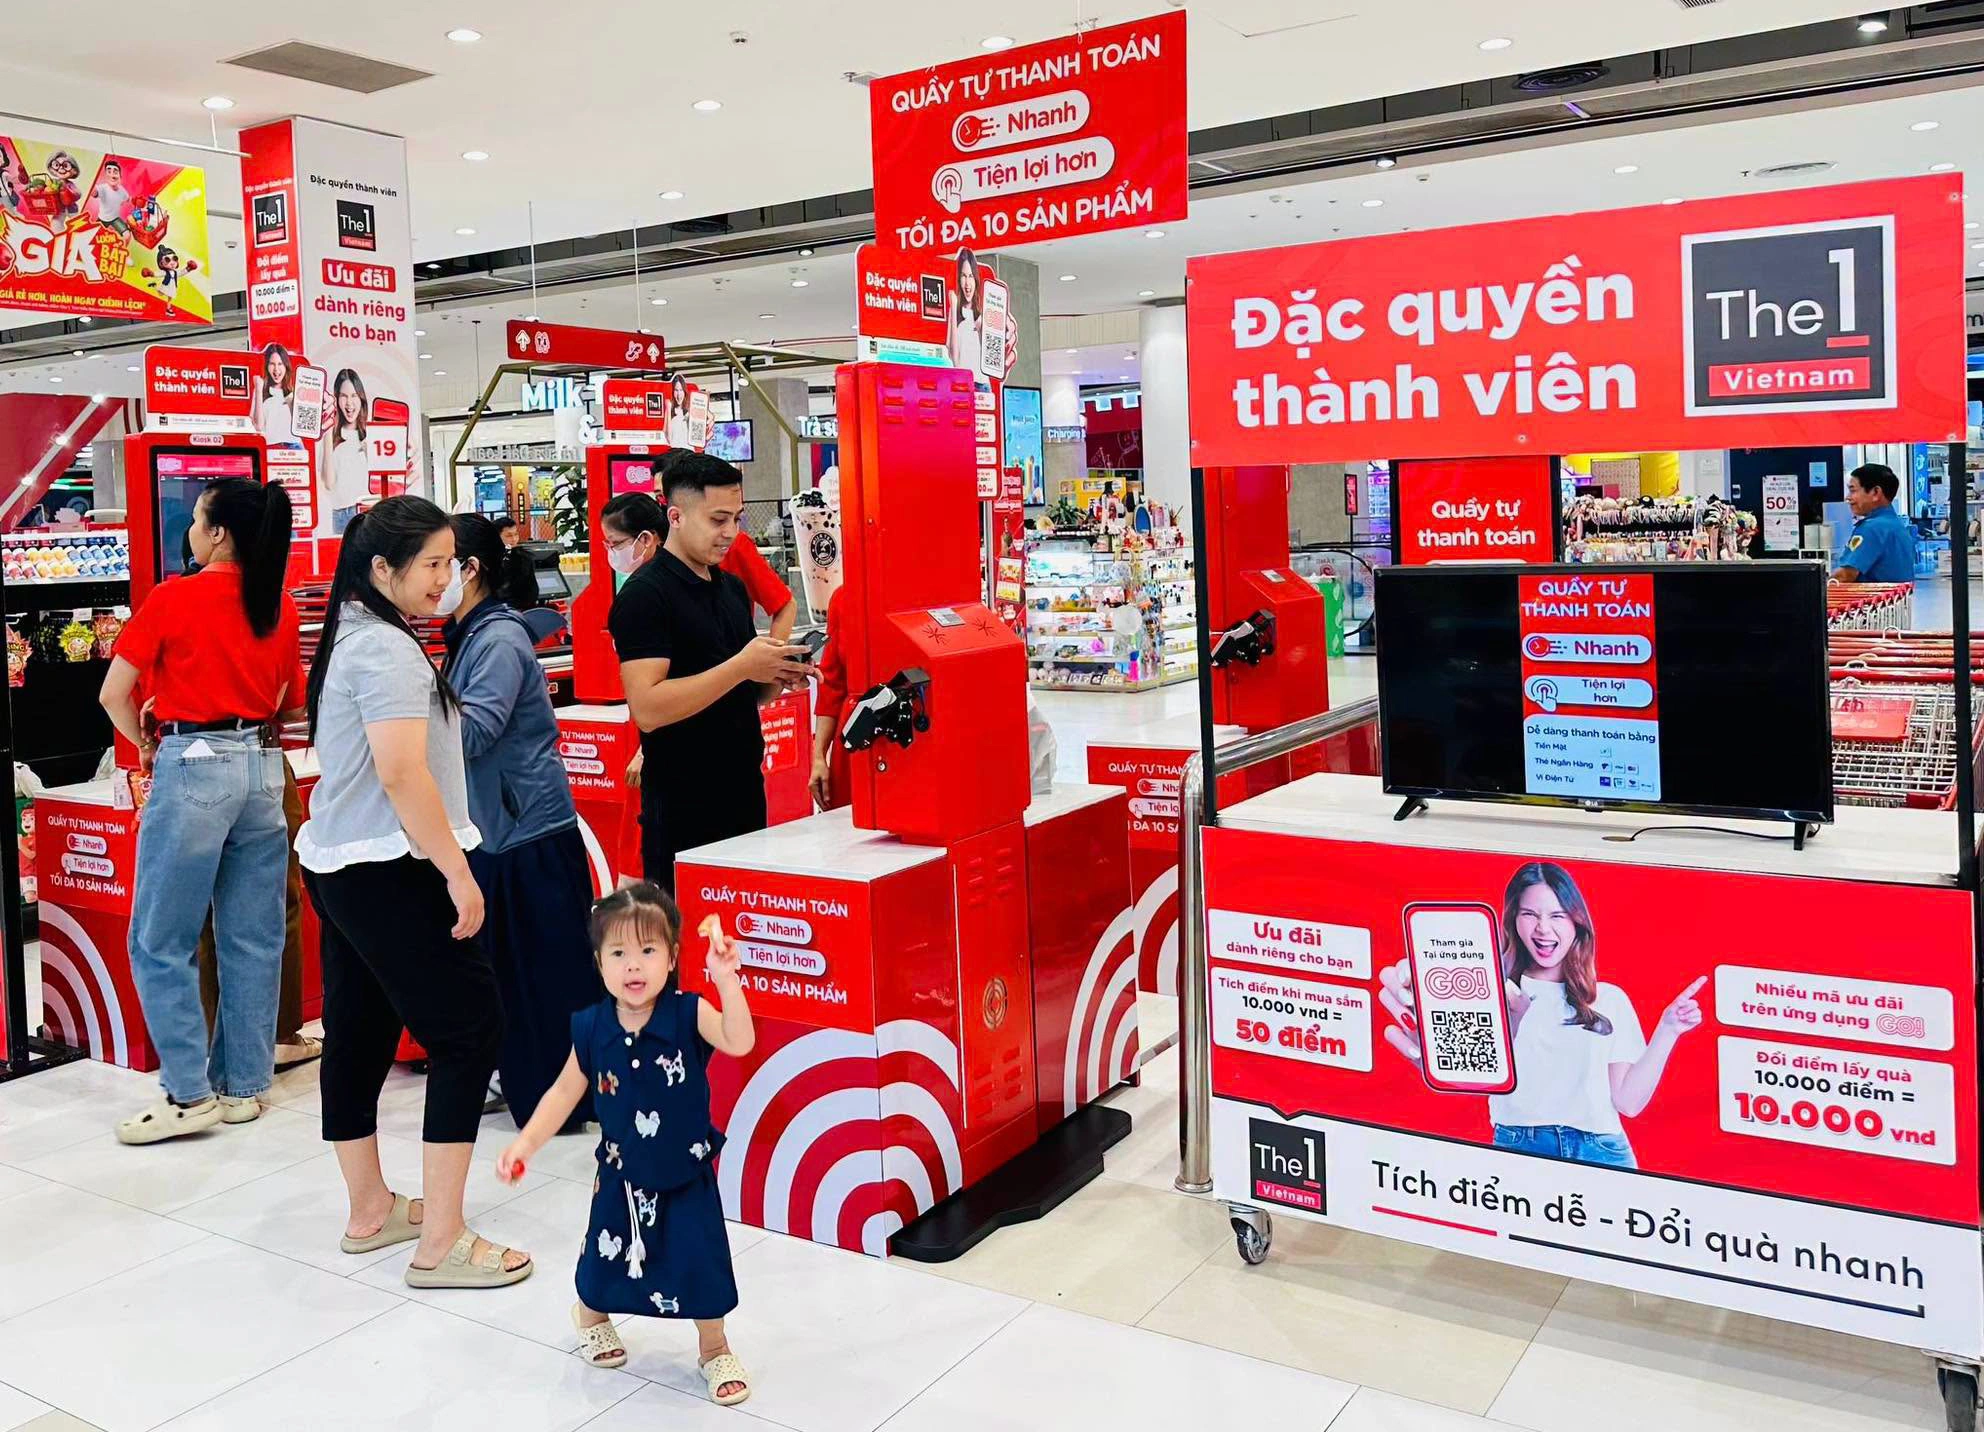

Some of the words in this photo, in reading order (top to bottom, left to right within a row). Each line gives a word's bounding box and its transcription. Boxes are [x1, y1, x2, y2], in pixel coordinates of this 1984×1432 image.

[891, 75, 954, 113] QUẦY
[959, 69, 995, 101] TỰ
[996, 52, 1081, 91] THANH
[1087, 33, 1161, 71] TOÁN
[1008, 101, 1077, 134] Nhanh
[973, 161, 1018, 189] Tiện
[1024, 155, 1049, 182] lợi
[1056, 149, 1097, 173] hơn
[310, 175, 326, 186] Đặc
[355, 183, 378, 194] thành
[380, 188, 397, 197] viên
[896, 215, 934, 250] TỐI
[941, 219, 976, 243] ĐA
[982, 211, 1009, 236] 10
[1015, 198, 1068, 233] SẢN
[1076, 180, 1153, 223] PHẨM
[8, 212, 104, 281] GIÁ
[327, 263, 356, 285] Ưu
[360, 269, 390, 289] đãi
[866, 271, 886, 290] Đặc
[256, 301, 285, 316] 10.000
[315, 295, 358, 314] dành
[363, 301, 406, 321] riêng
[865, 293, 894, 310] thành
[896, 298, 917, 313] viên
[1231, 289, 1366, 360] Đặc
[1387, 254, 1634, 348] quyền
[329, 322, 361, 339] cho
[366, 325, 396, 345] bạn
[155, 366, 178, 379] Đặc
[1724, 366, 1855, 390] Vietnam
[154, 381, 188, 393] thành
[191, 383, 215, 394] viên
[1233, 364, 1440, 428] thành
[1464, 350, 1637, 416] viên
[578, 415, 598, 444] &
[1047, 428, 1081, 440] Charging
[374, 440, 396, 457] 19
[1431, 499, 1490, 522] Quầy
[1495, 499, 1521, 520] tự
[1417, 526, 1477, 547] thanh
[1481, 524, 1536, 547] toán
[1538, 576, 1593, 597] QUẦY
[1598, 578, 1628, 599] TỰ
[1521, 602, 1589, 617] THANH
[1594, 598, 1650, 617] TOÁN
[1574, 641, 1639, 657] Nhanh
[1582, 679, 1608, 690] Tiện
[1610, 680, 1626, 692] lợi
[1593, 692, 1617, 703] hơn
[572, 732, 595, 740] THANH
[1543, 726, 1568, 738] dàng
[1571, 728, 1600, 738] thanh
[1602, 730, 1625, 740] toán
[1628, 731, 1656, 743] bằng
[1140, 764, 1156, 776] TỰ
[1148, 802, 1168, 813] Tiện
[47, 813, 67, 827] QUẦY
[68, 818, 79, 830] TỰ
[79, 819, 104, 832] THANH
[105, 822, 125, 834] TOÁN
[1133, 821, 1150, 832] ĐA
[1152, 822, 1164, 832] 10
[82, 839, 104, 850] Nhanh
[73, 857, 87, 869] Tiện
[88, 859, 96, 871] lợi
[97, 861, 109, 872] hơn
[50, 872, 63, 886] TỐI
[64, 877, 74, 887] ĐA
[76, 878, 85, 888] 10
[86, 877, 101, 891] SẢN
[103, 880, 125, 896] PHẨM
[701, 885, 737, 904] QUẦY
[739, 891, 759, 908] TỰ
[760, 894, 807, 912] THANH
[809, 899, 848, 918] TOÁN
[767, 921, 805, 938] Nhanh
[1254, 920, 1285, 939] Ưu
[1289, 927, 1322, 947] đãi
[1423, 950, 1439, 960] Tại
[1441, 949, 1458, 961] ứng
[1459, 950, 1485, 961] dụng
[1430, 939, 1454, 947] Tham
[1456, 939, 1474, 949] gia
[748, 947, 774, 962] Tiện
[776, 951, 790, 967] lợi
[793, 953, 817, 969] hơn
[1226, 941, 1259, 957] dành
[1262, 946, 1296, 963] riêng
[1299, 951, 1325, 966] cho
[1328, 954, 1353, 971] bạn
[753, 976, 769, 991] 10
[772, 976, 801, 997] SẢN
[805, 982, 848, 1004] PHẨM
[1218, 976, 1245, 990] Tích
[1248, 978, 1280, 996] điểm
[1282, 984, 1303, 999] khi
[1304, 990, 1334, 1004] mua
[1335, 990, 1363, 1009] sắm
[1424, 966, 1491, 1000] GO!
[1755, 981, 1807, 1000] Nhiều
[1812, 988, 1841, 1004] mã
[1846, 992, 1869, 1006] ưu
[1874, 993, 1904, 1010] đãi
[1242, 996, 1295, 1016] 10.000
[1299, 1004, 1329, 1021] vnd
[1332, 1011, 1343, 1021] =
[1741, 1001, 1778, 1017] trên
[1783, 1005, 1817, 1024] ứng
[1822, 1009, 1870, 1030] dụng
[1876, 1013, 1925, 1038] GO!
[1235, 1018, 1272, 1043] 50
[1278, 1020, 1347, 1057] điểm
[1756, 1051, 1787, 1067] Đổi
[1792, 1056, 1838, 1074] điểm
[1843, 1061, 1870, 1079] lấy
[1877, 1068, 1912, 1083] quà
[1754, 1070, 1831, 1093] 10.000
[1838, 1080, 1895, 1102] điểm
[1902, 1091, 1915, 1102] =
[1734, 1092, 1884, 1138] 10.000
[1890, 1128, 1936, 1146] vnd
[1261, 1184, 1315, 1205] Vietnam
[1371, 1160, 1438, 1202] Tích
[1448, 1173, 1532, 1219] điểm
[1543, 1190, 1587, 1228] dễ
[1624, 1205, 1693, 1249] Đổi
[1704, 1228, 1780, 1264] quà
[1794, 1246, 1925, 1290] nhanh
